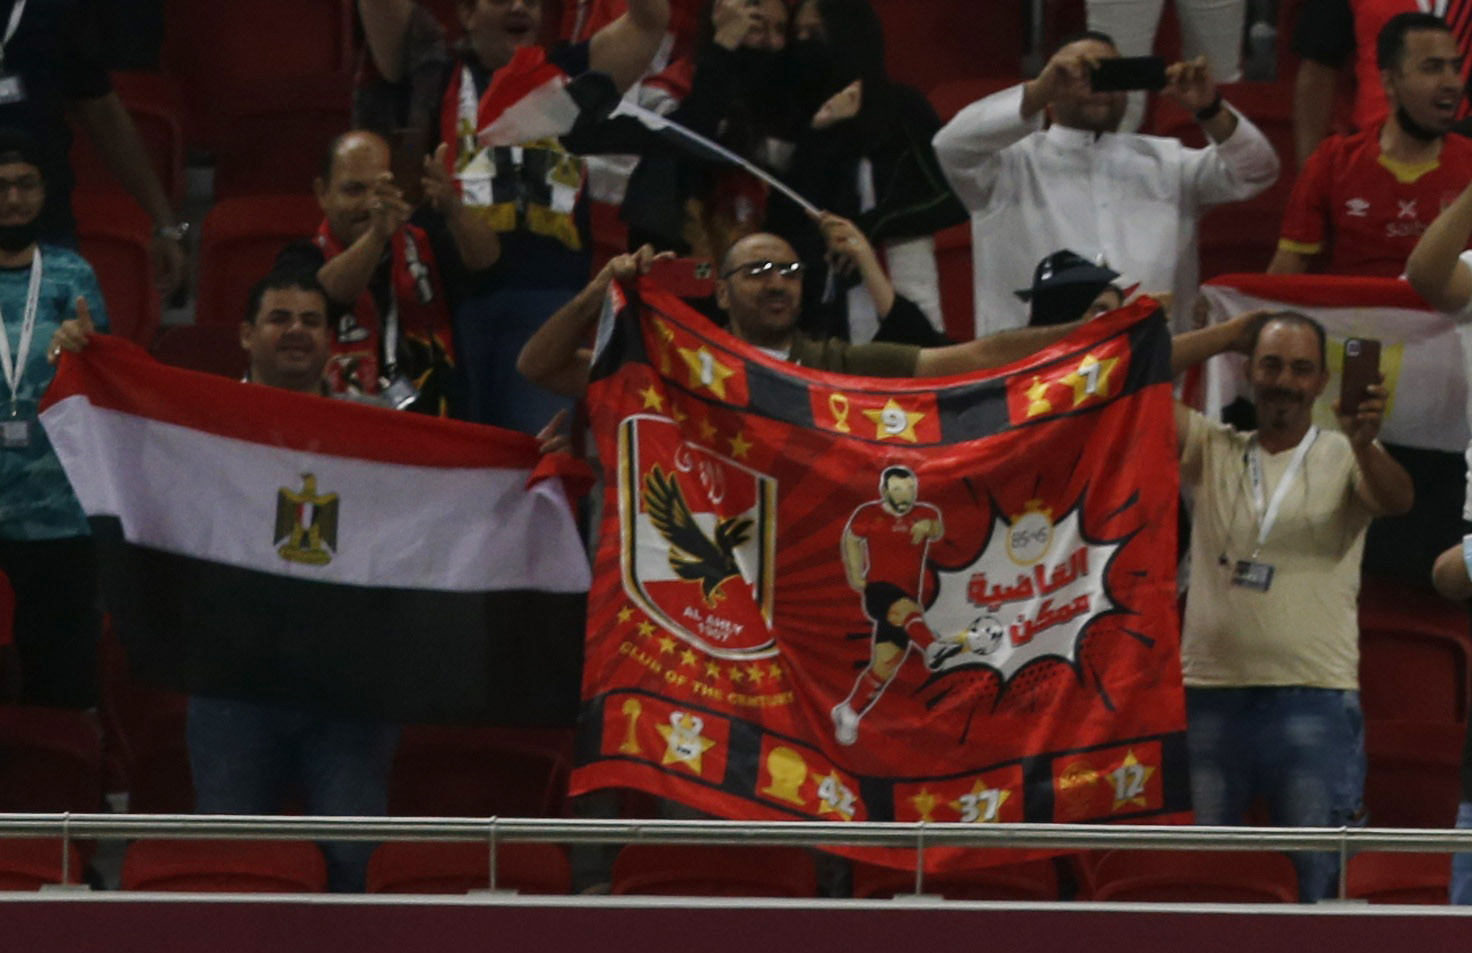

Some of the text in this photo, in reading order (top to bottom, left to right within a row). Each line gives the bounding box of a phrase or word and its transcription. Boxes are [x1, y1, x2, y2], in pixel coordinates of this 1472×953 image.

[881, 409, 908, 434] 9
[967, 547, 1089, 612] القاضية
[1009, 595, 1090, 647] ممكن
[1112, 764, 1145, 801] 12
[958, 788, 1000, 823] 37
